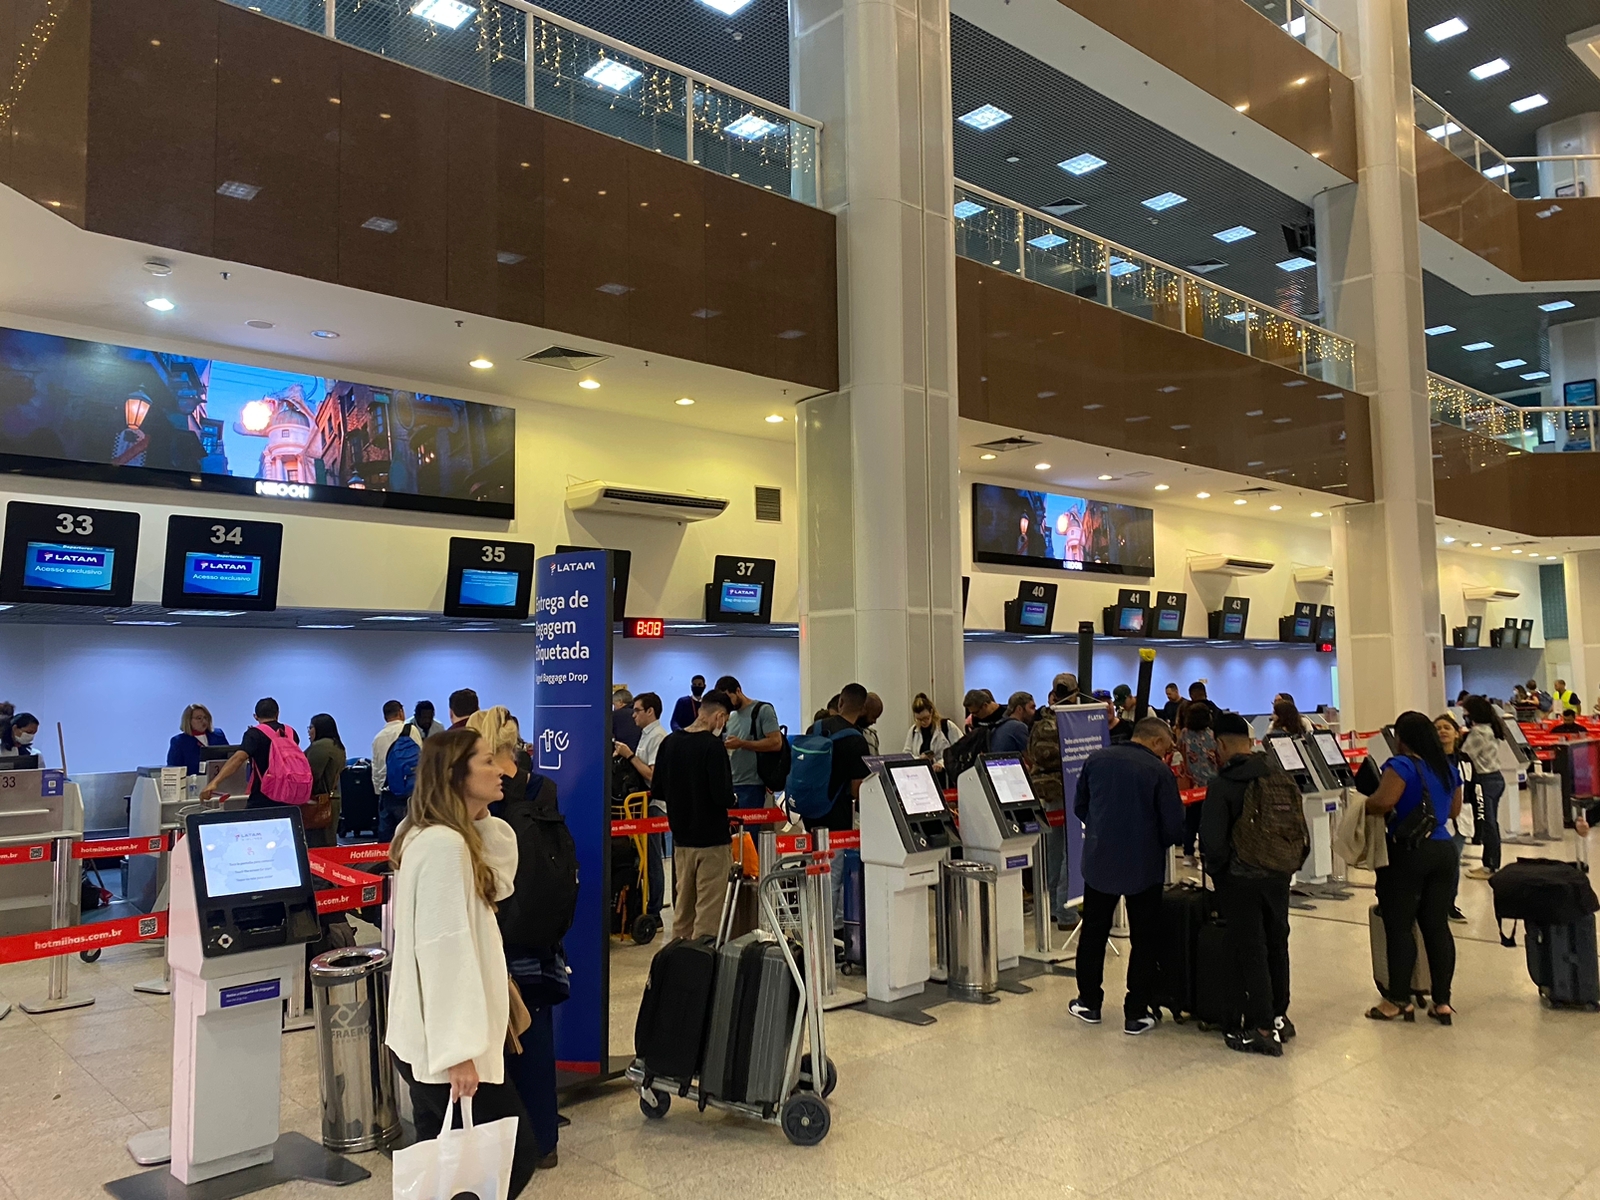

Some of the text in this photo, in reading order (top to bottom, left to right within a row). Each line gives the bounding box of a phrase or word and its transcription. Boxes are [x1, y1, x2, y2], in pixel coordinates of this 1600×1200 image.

[55, 513, 93, 535] 33
[210, 525, 242, 545] 34
[55, 554, 97, 563] LATAM
[481, 546, 505, 562] 35
[35, 565, 65, 573] Acesso
[210, 563, 246, 571] LATAM
[557, 562, 595, 572] LATAM
[736, 562, 755, 576] 37
[220, 574, 251, 582] exclusivo
[1032, 586, 1044, 597] 40
[569, 590, 589, 608] de
[1130, 593, 1140, 603] 41
[1167, 595, 1177, 605] 42
[636, 621, 661, 636] 8:08
[568, 672, 588, 684] Drop
[2, 776, 16, 788] 33
[81, 843, 138, 854] hotmilhas.com.br
[34, 929, 122, 950] hotmilhas.com.br
